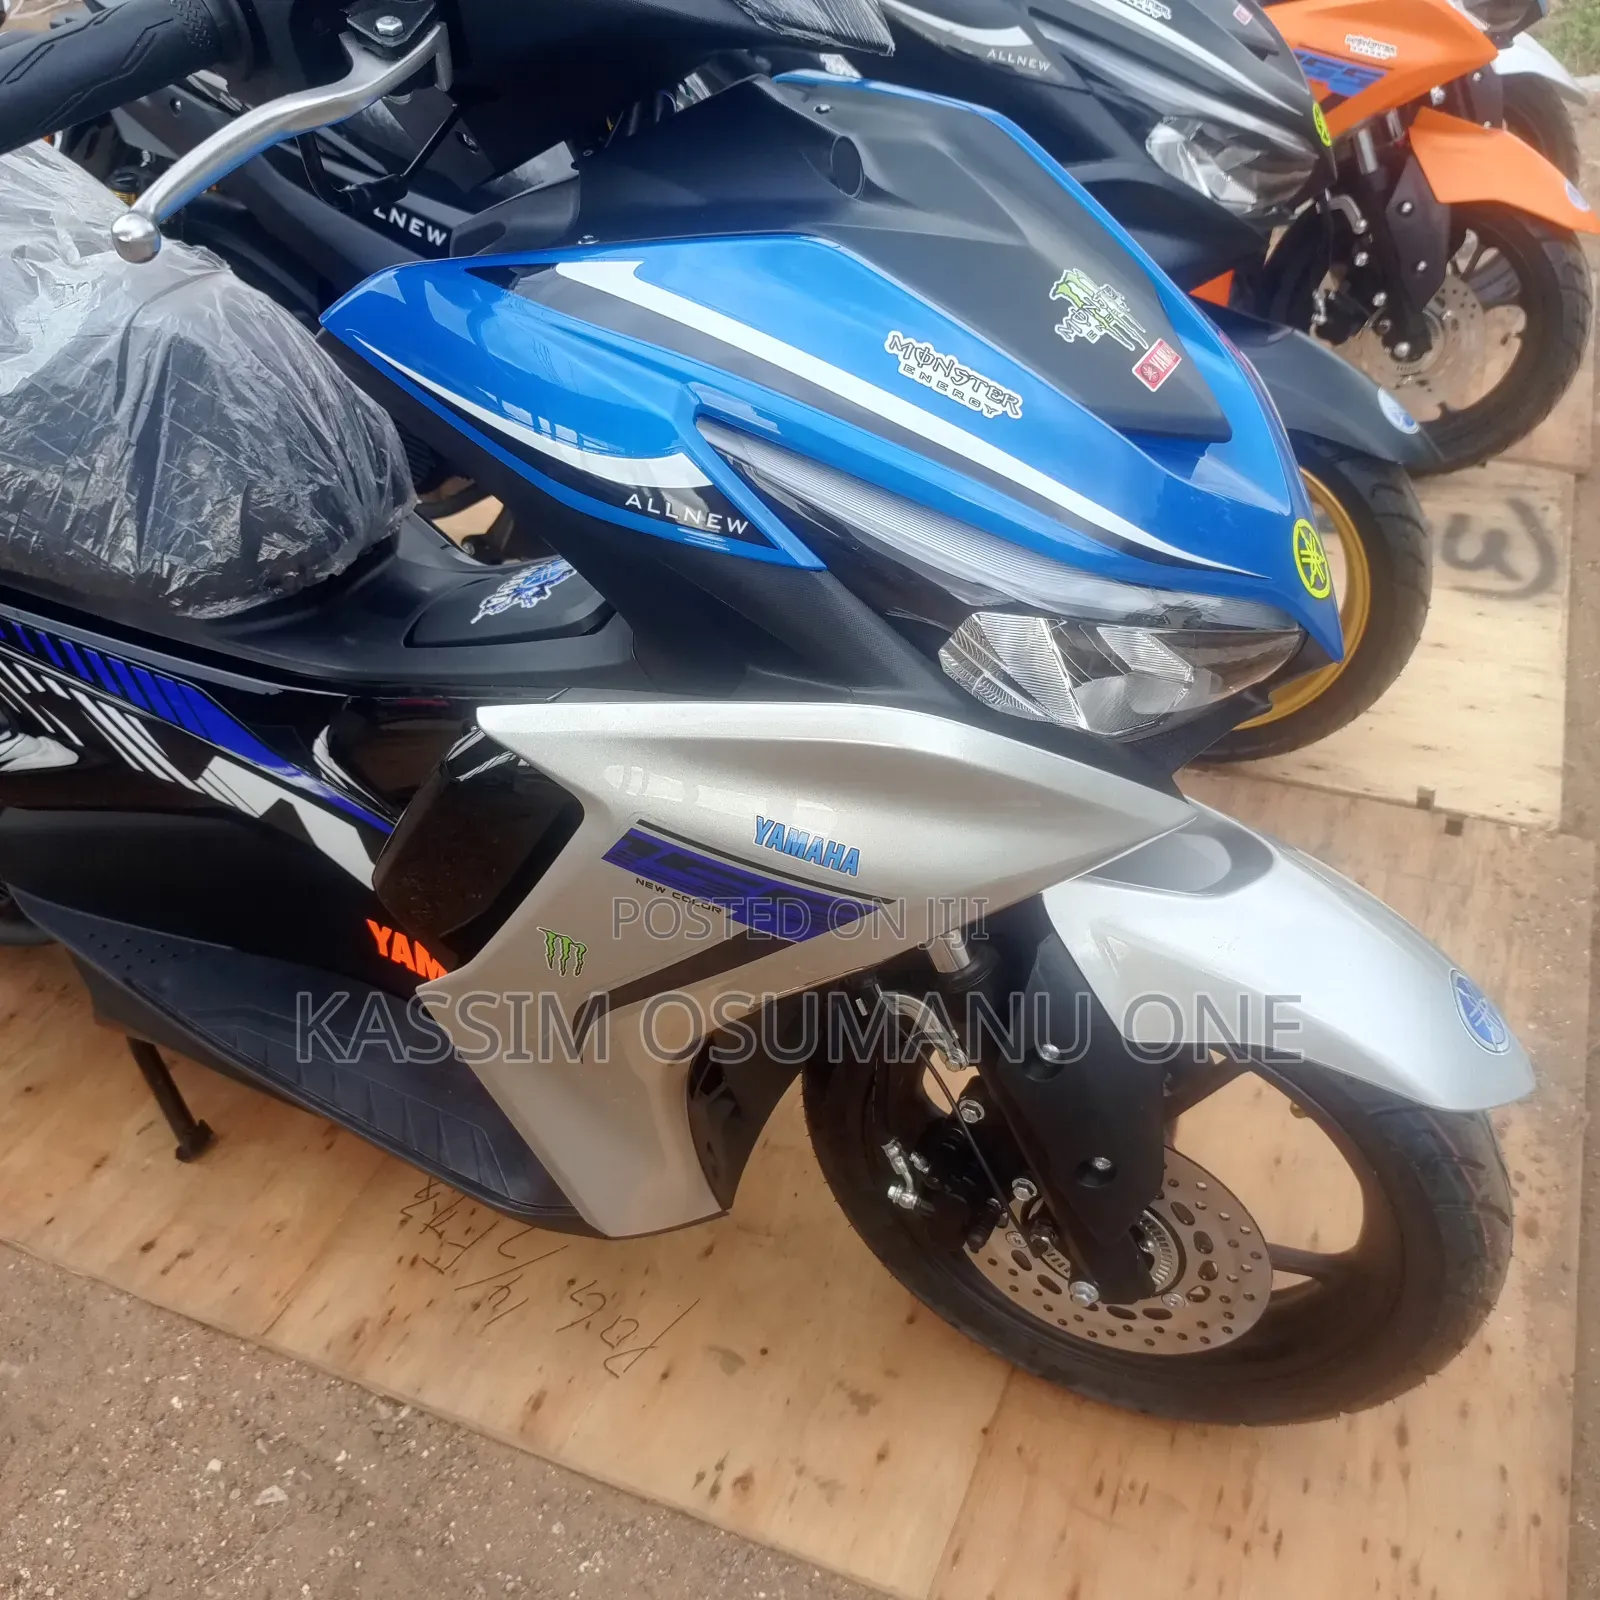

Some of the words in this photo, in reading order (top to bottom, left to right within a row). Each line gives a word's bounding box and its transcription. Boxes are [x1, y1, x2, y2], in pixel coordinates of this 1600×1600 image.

[987, 48, 1051, 73] ALLNEW
[888, 334, 1020, 416] MONSTER
[903, 363, 998, 415] ENERGY
[625, 493, 748, 535] ALLNEW
[755, 815, 861, 877] YAMAHA
[635, 877, 666, 894] NEW
[672, 892, 722, 914] COLOR
